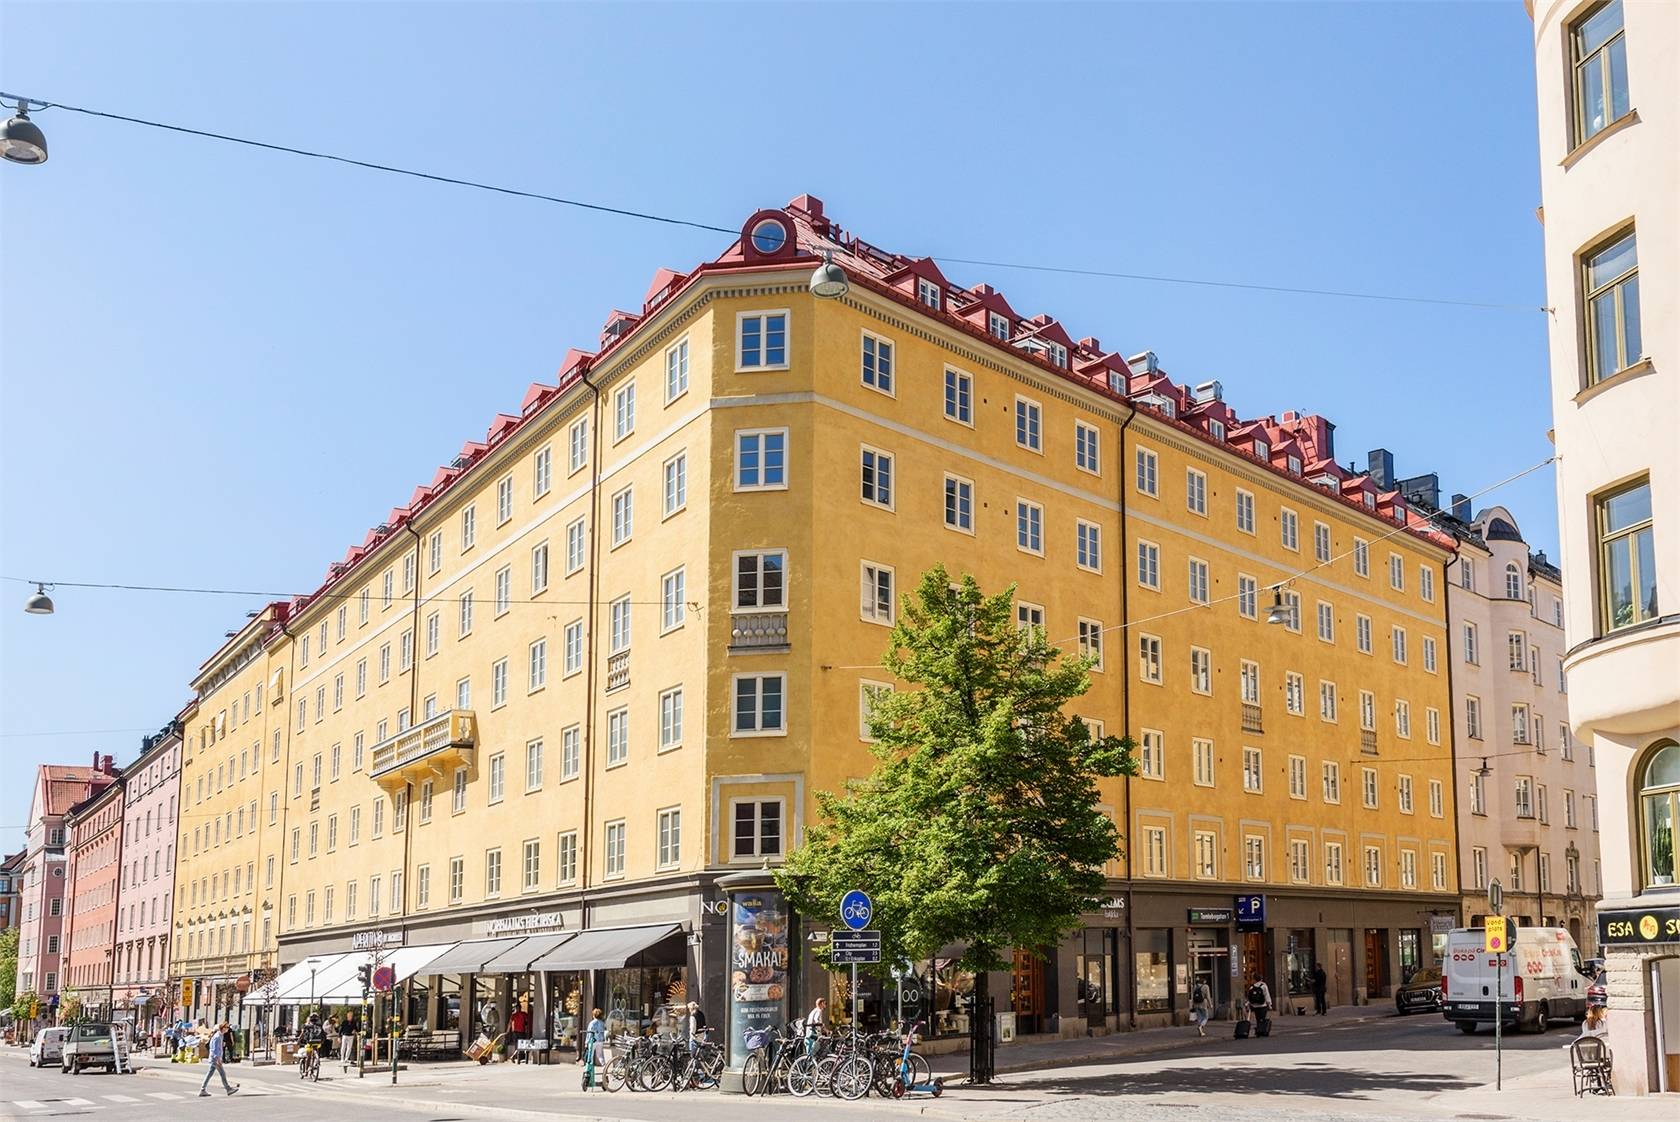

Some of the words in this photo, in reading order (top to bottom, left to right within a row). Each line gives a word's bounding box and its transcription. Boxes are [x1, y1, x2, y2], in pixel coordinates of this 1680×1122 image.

[1251, 901, 1260, 914] P
[1608, 921, 1634, 937] ESA
[738, 951, 782, 968] SMAKA!
